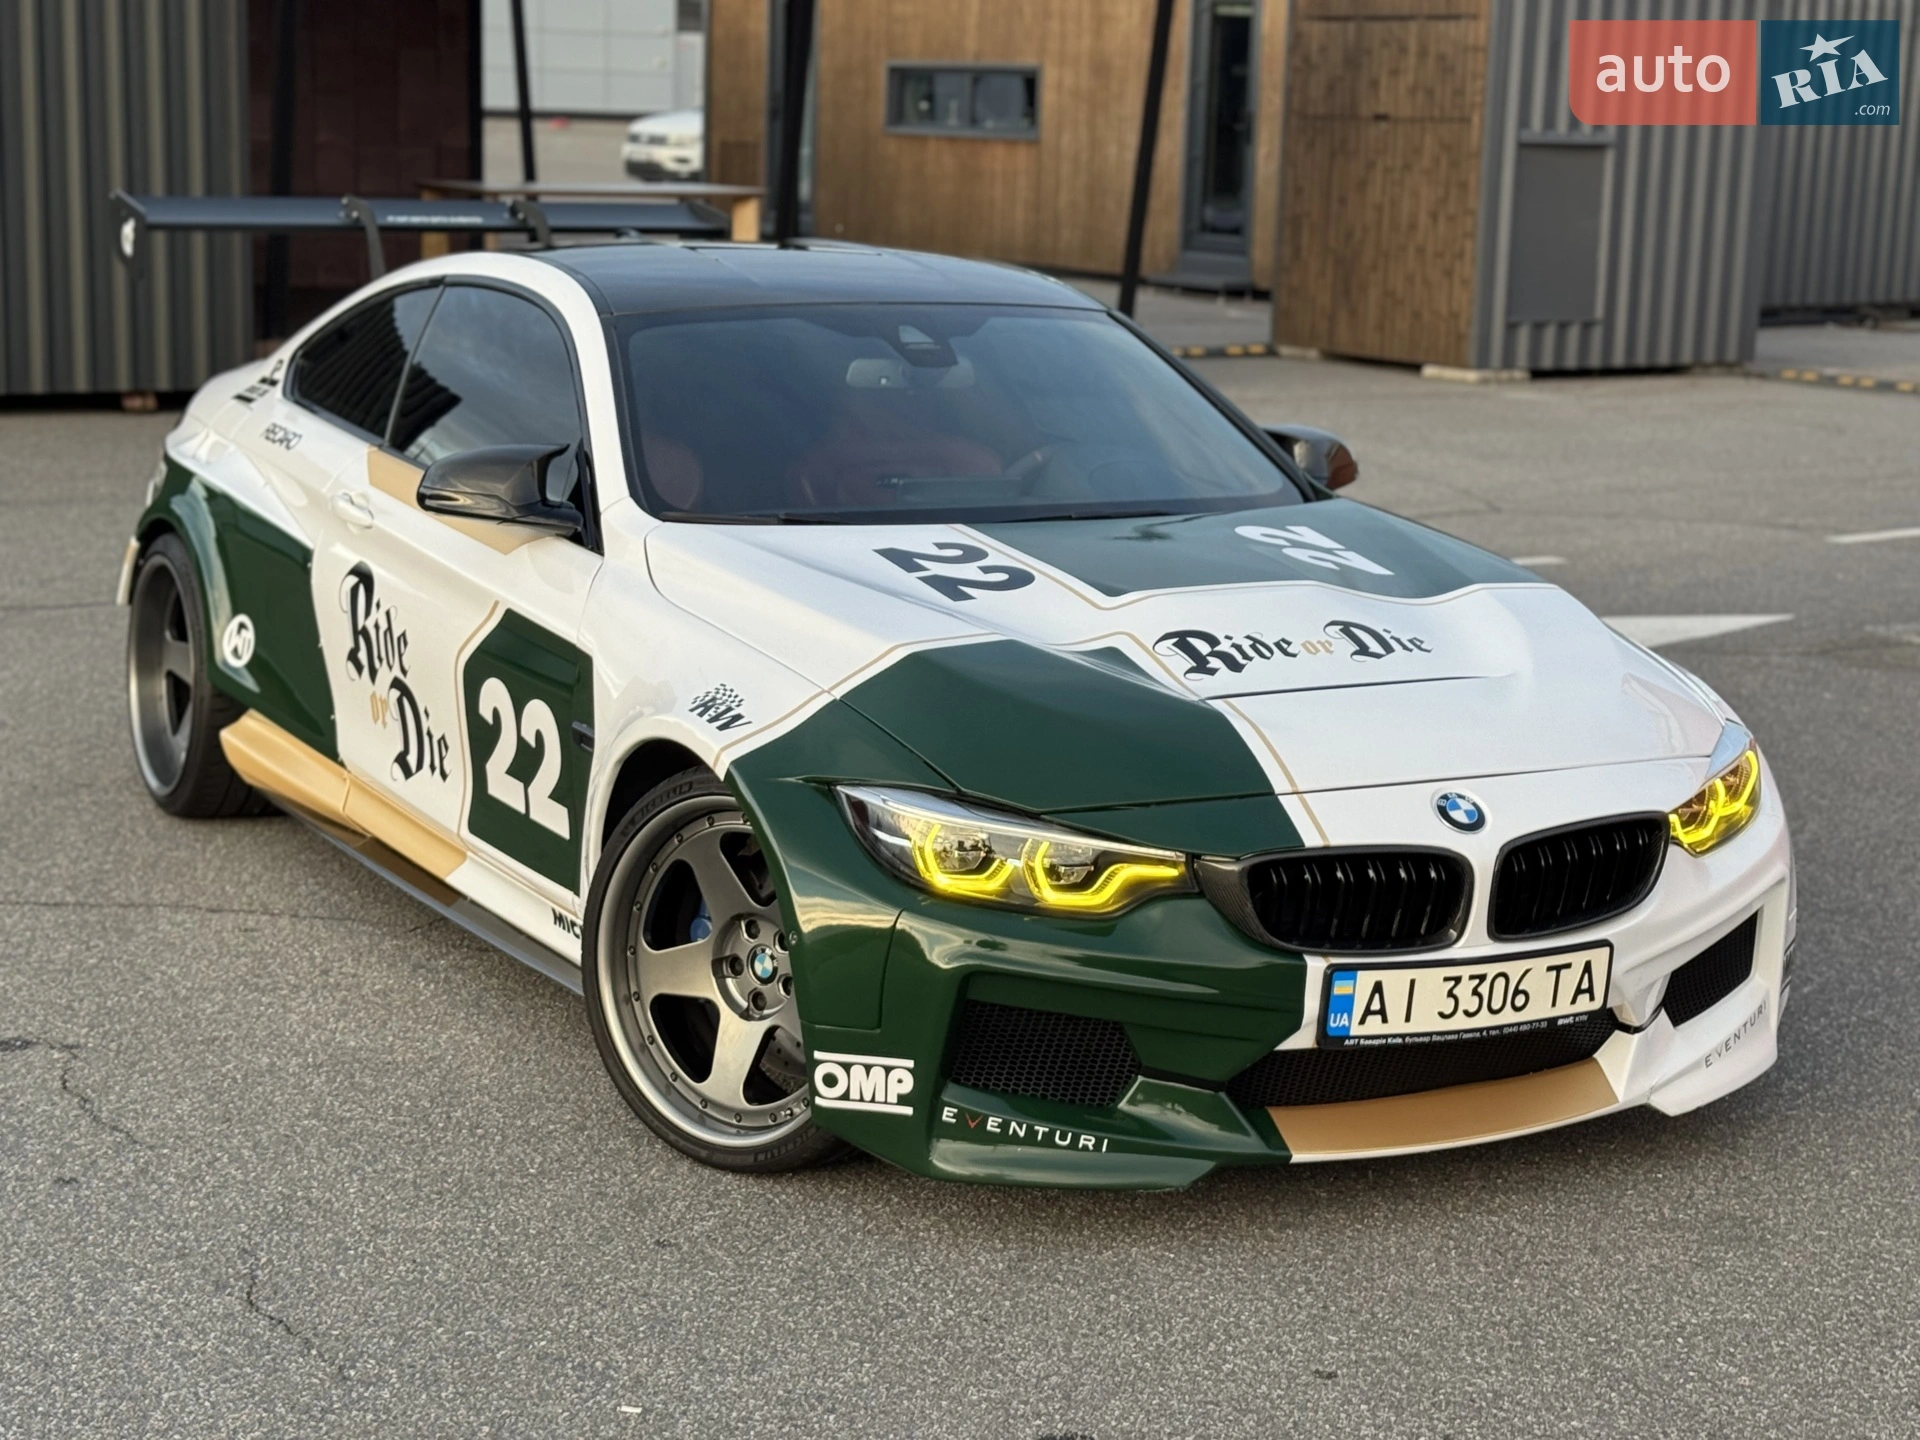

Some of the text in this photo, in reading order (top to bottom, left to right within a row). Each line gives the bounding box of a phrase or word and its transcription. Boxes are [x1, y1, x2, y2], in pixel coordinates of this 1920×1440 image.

[872, 541, 1036, 602] 22
[1234, 525, 1395, 576] 22
[339, 560, 411, 686] Ride
[1153, 619, 1434, 681] Ride or Die
[370, 690, 389, 730] or
[387, 675, 452, 783] Die
[478, 676, 571, 841] 22
[551, 906, 584, 940] MIC
[1329, 1012, 1349, 1028] UA
[1358, 959, 1596, 1026] AI 3306 TA
[1704, 999, 1767, 1069] EVENTURI
[814, 1061, 914, 1104] OMP
[942, 1107, 1109, 1153] EVENTURI
